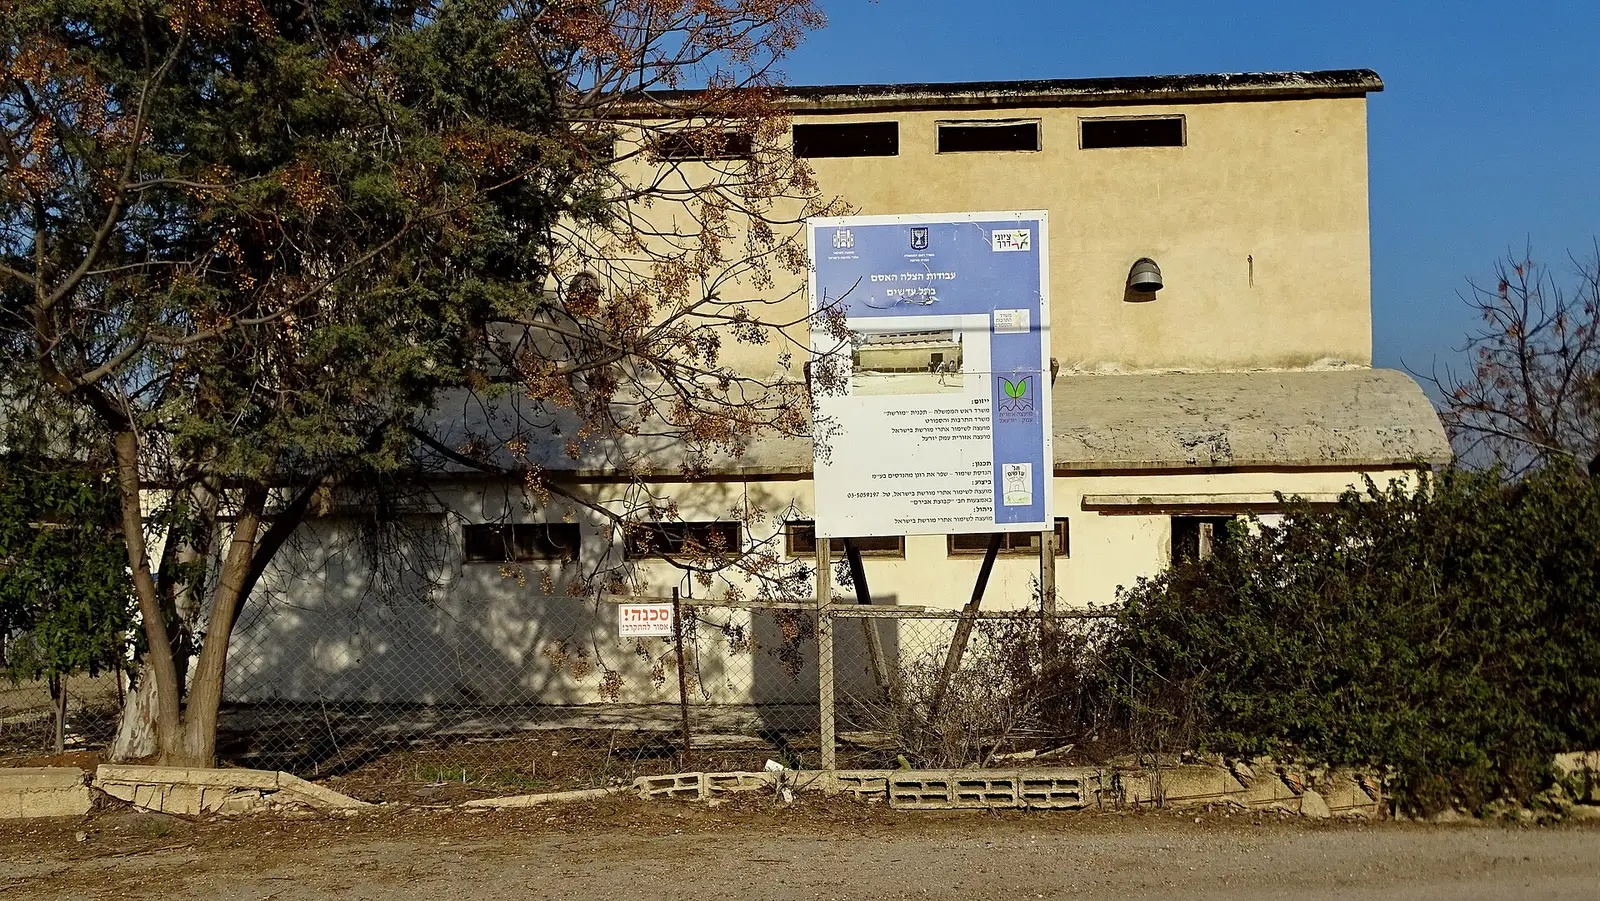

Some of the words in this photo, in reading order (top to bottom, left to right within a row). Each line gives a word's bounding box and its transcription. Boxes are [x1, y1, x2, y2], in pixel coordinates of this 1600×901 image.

[997, 241, 1011, 249] דרך
[870, 274, 898, 282] האסם
[901, 272, 924, 281] הצלה
[926, 272, 956, 280] עבודות
[886, 288, 916, 296] עדשים
[624, 608, 669, 621] סכנה!
[623, 622, 651, 632] להתקרב!
